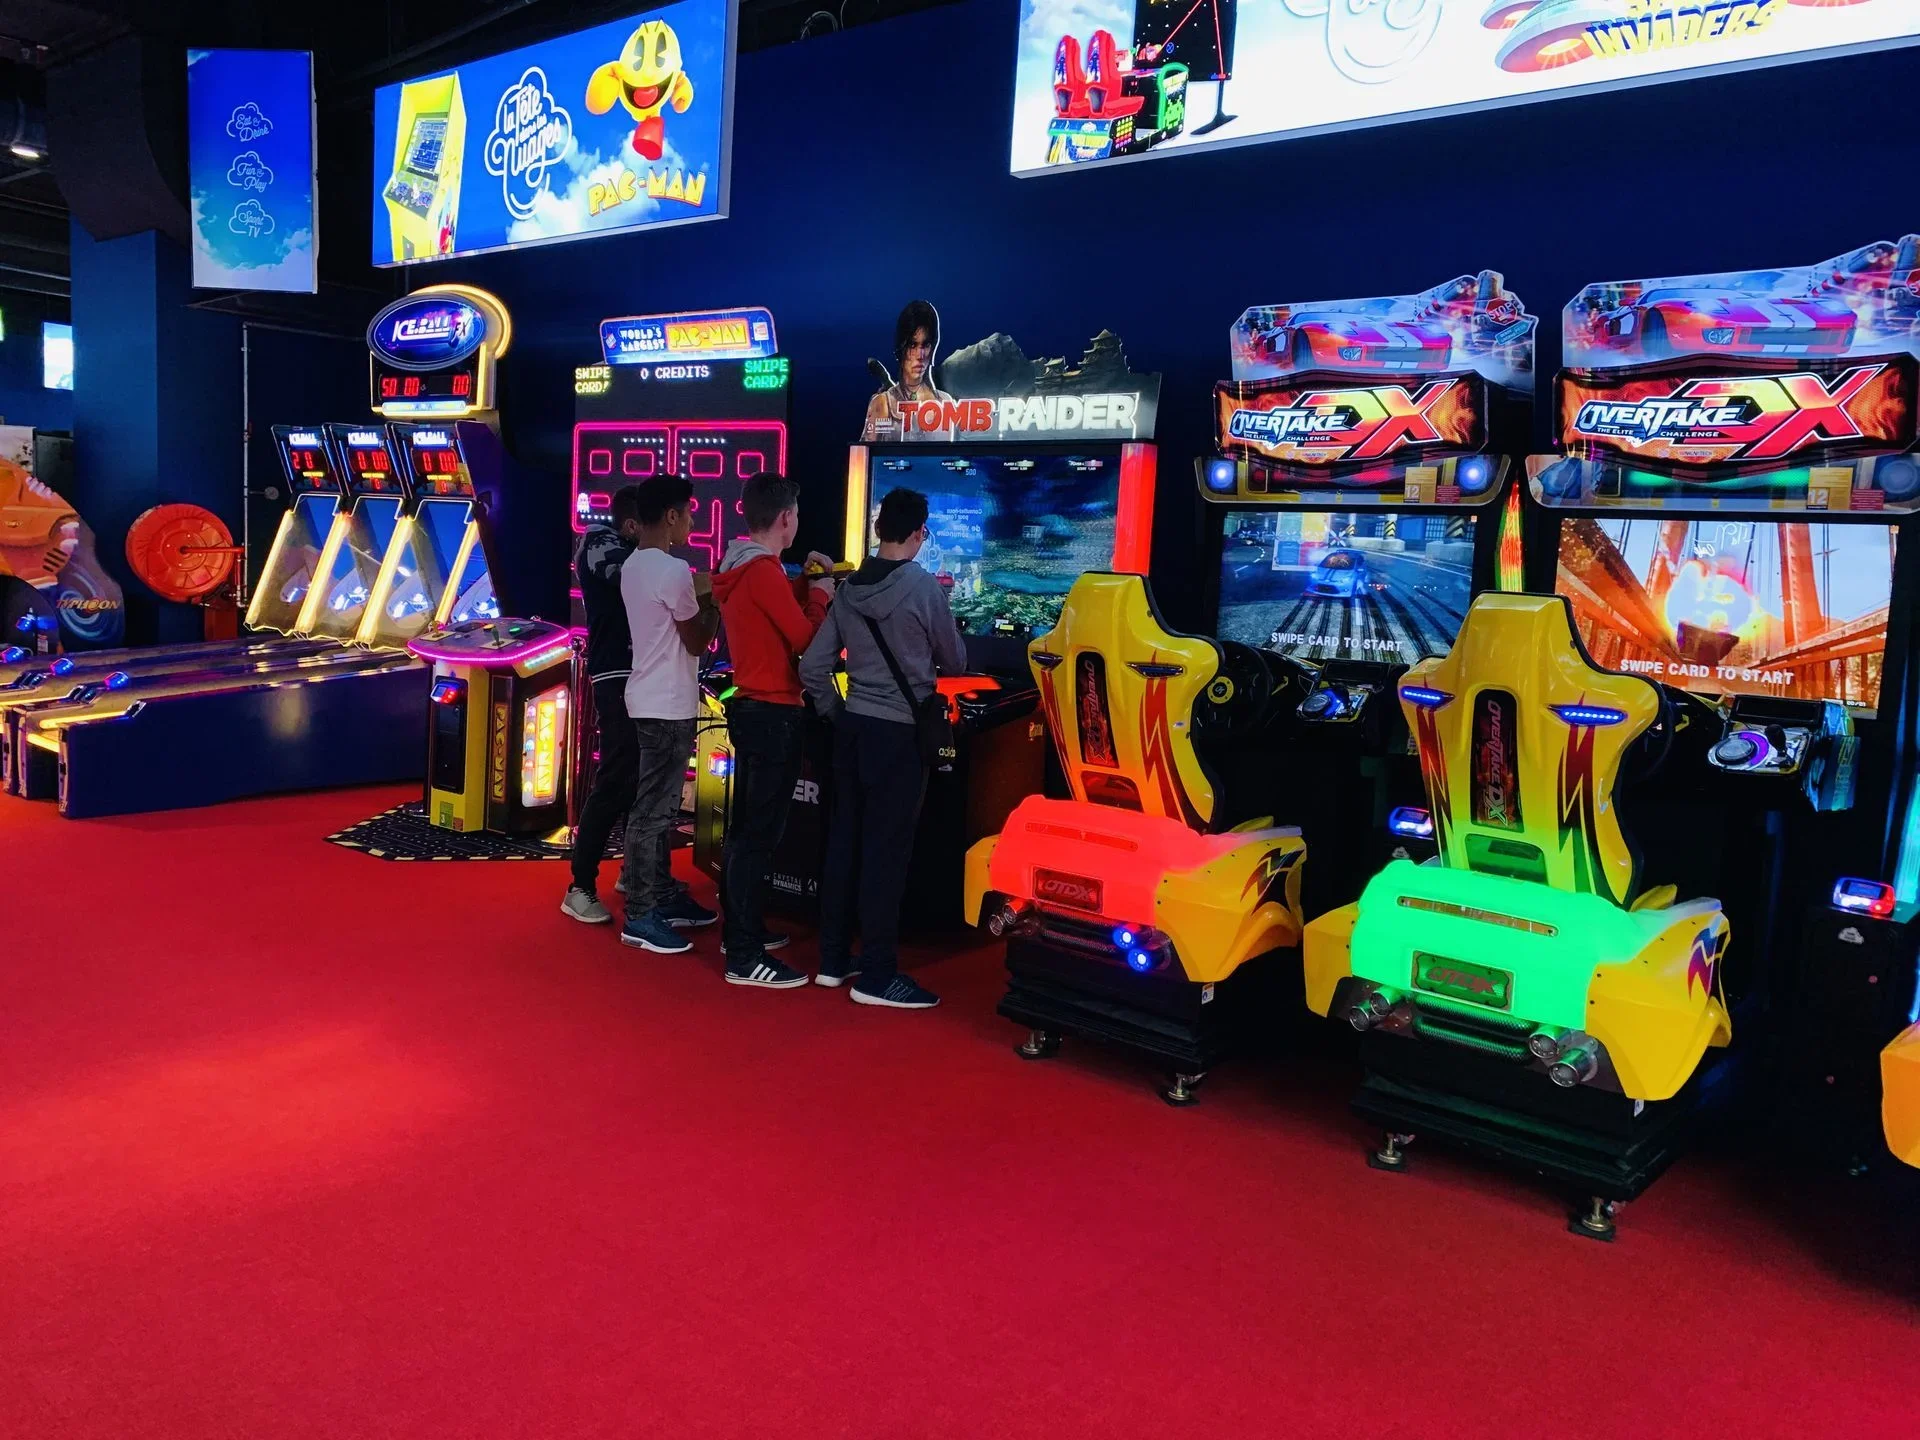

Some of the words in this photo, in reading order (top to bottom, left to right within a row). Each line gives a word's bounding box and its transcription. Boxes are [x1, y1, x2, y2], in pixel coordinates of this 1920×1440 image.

[1581, 0, 1780, 59] INVADERS
[240, 124, 269, 142] Drink
[237, 163, 256, 176] Fun
[244, 176, 267, 193] Play
[588, 166, 706, 217] PAC-MAN
[248, 225, 261, 238] TV
[1489, 302, 1514, 319] STOP
[620, 326, 662, 340] WORLD'S
[668, 322, 748, 348] PAC-MAN
[620, 338, 665, 352] LARGEST
[575, 367, 611, 380] SWIPE
[640, 367, 649, 380] 0
[655, 365, 710, 379] CREDITS
[744, 358, 789, 373] SWIPE
[575, 381, 609, 394] CARD!
[743, 374, 786, 390] CARD!
[898, 399, 994, 433] TOMB
[998, 393, 1139, 432] RAIDER
[1231, 409, 1346, 438] OVERTAKE
[1300, 380, 1457, 459] DX
[1580, 401, 1740, 435] OVERTAKE
[1683, 364, 1887, 460] DX
[1407, 485, 1420, 498] 12
[1810, 489, 1828, 505] 12
[56, 599, 120, 610] TYPHOON
[1271, 632, 1304, 645] SWIPE
[1308, 635, 1340, 647] CARD
[1343, 637, 1360, 648] TO
[1363, 639, 1403, 652] START
[1620, 659, 1663, 674] SWIPE
[1668, 663, 1710, 678] CARD
[1716, 666, 1736, 680] TO
[1742, 669, 1794, 685] START
[1487, 699, 1503, 785] OVERTAKE
[772, 878, 802, 892] DYNAMICS
[1044, 879, 1092, 902] OTDX
